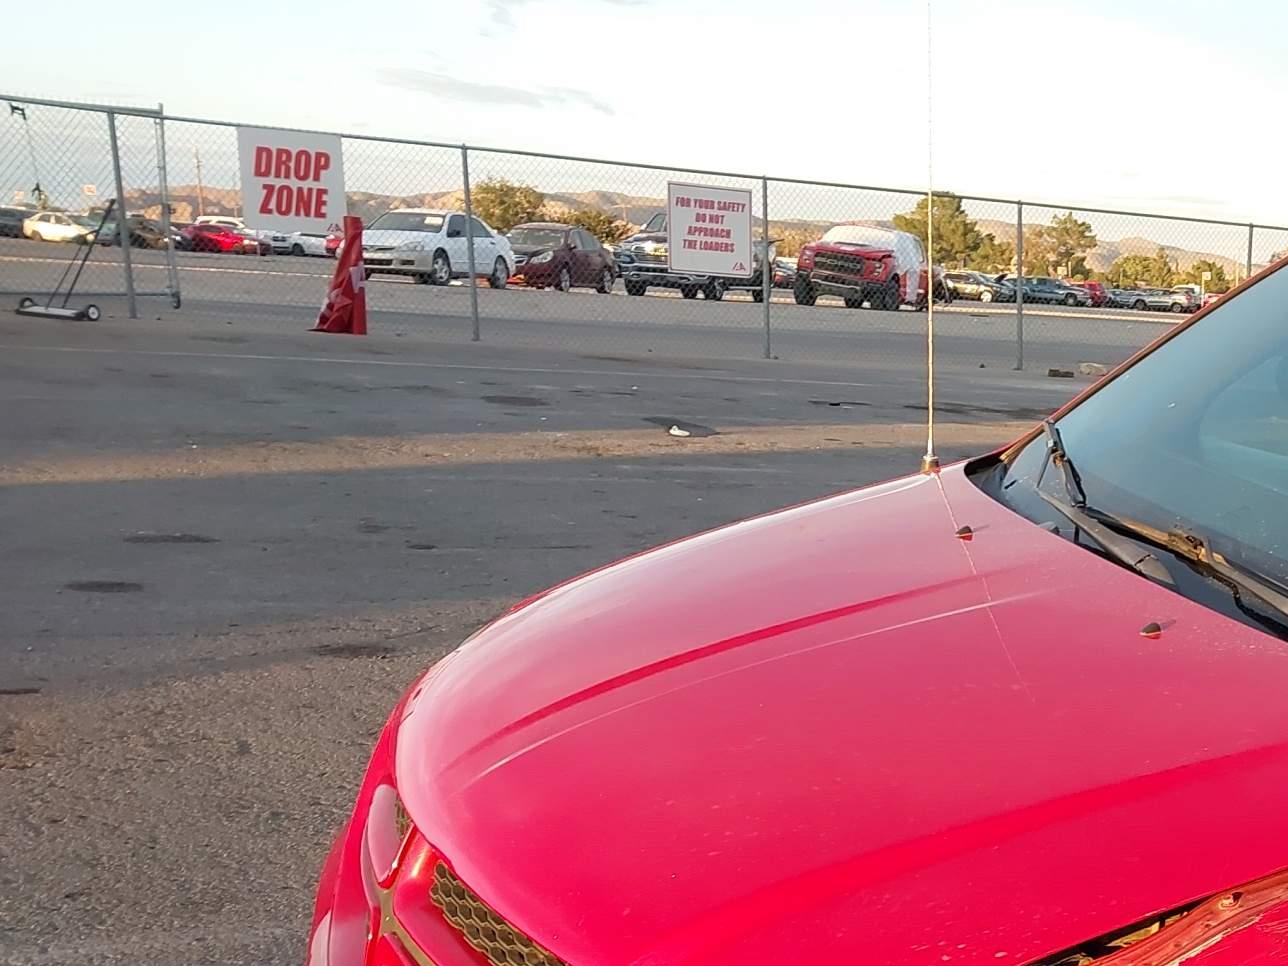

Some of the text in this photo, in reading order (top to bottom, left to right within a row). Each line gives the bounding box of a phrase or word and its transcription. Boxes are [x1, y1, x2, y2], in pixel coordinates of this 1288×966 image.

[254, 146, 331, 182] DROP
[259, 183, 329, 219] ZONE
[675, 196, 746, 213] FOR YOUR SAFETY
[695, 212, 725, 225] DO NOT
[687, 225, 731, 239] APPROACH
[682, 239, 735, 253] THE LOADERS
